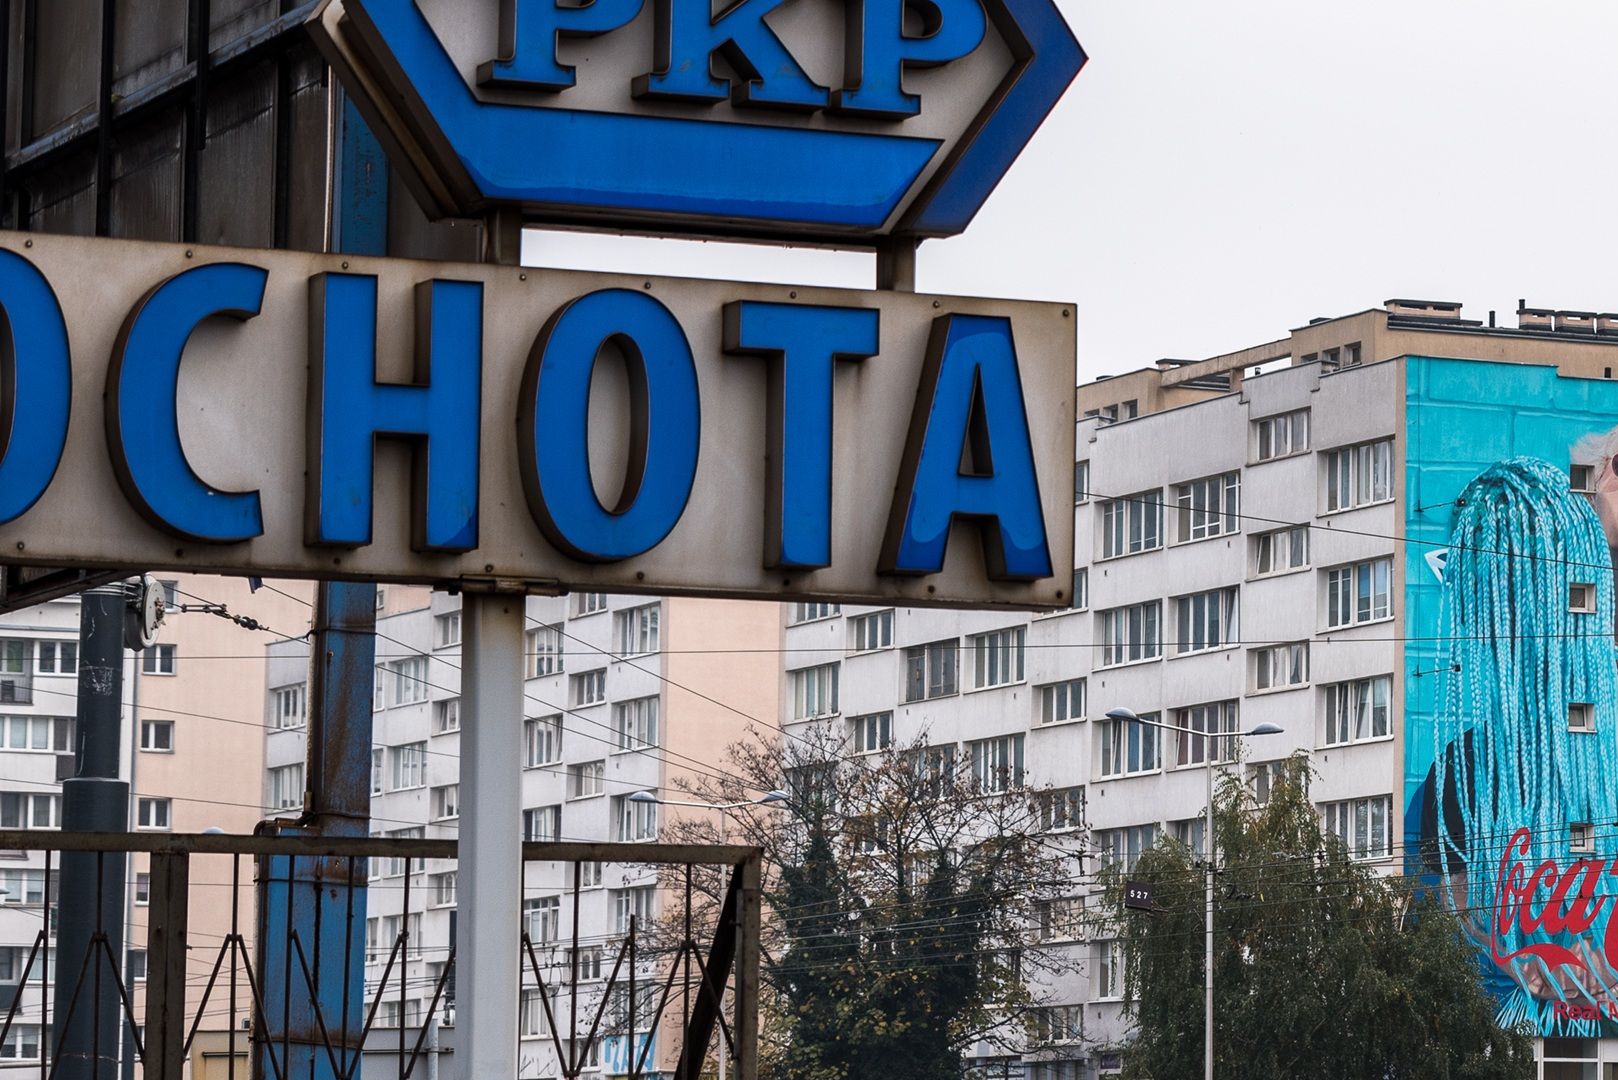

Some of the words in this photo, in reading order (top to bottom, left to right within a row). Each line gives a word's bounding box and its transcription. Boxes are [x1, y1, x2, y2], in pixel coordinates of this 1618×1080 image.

[477, 0, 987, 119] PKP
[1130, 889, 1149, 899] 527
[1553, 1001, 1600, 1021] Real
